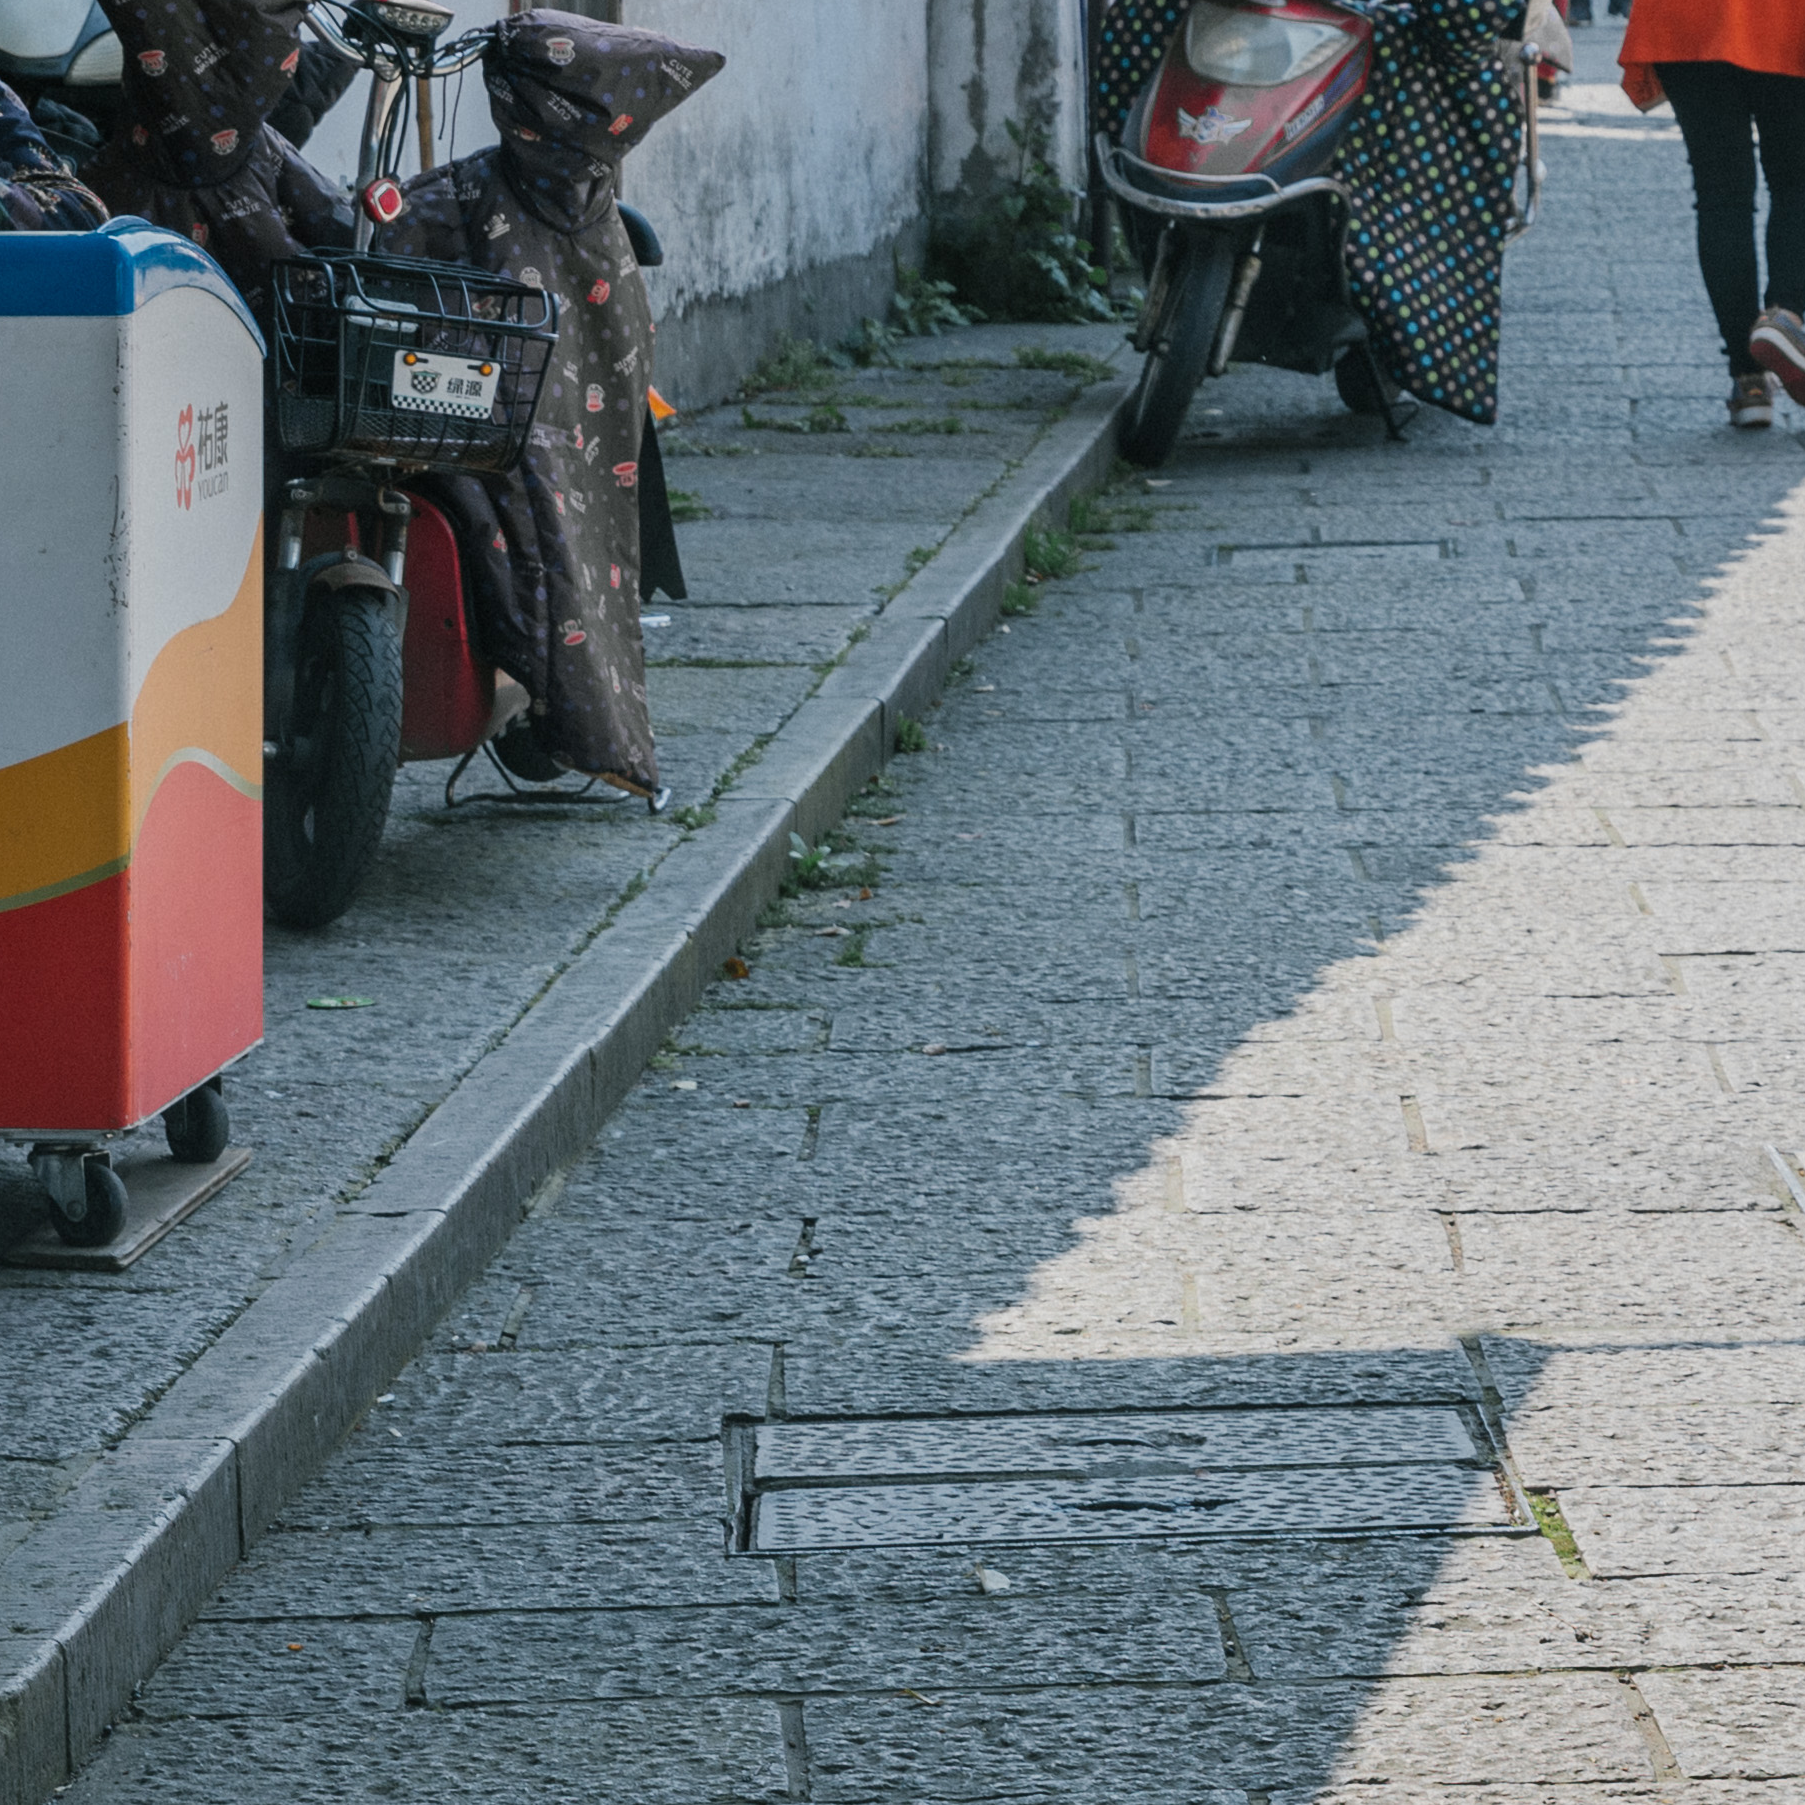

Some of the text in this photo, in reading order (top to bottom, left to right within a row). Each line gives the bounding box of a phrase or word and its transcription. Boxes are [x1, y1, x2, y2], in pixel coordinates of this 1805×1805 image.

[669, 58, 694, 80] CUTE
[447, 377, 483, 398] 绿源
[197, 401, 229, 474] 祐康
